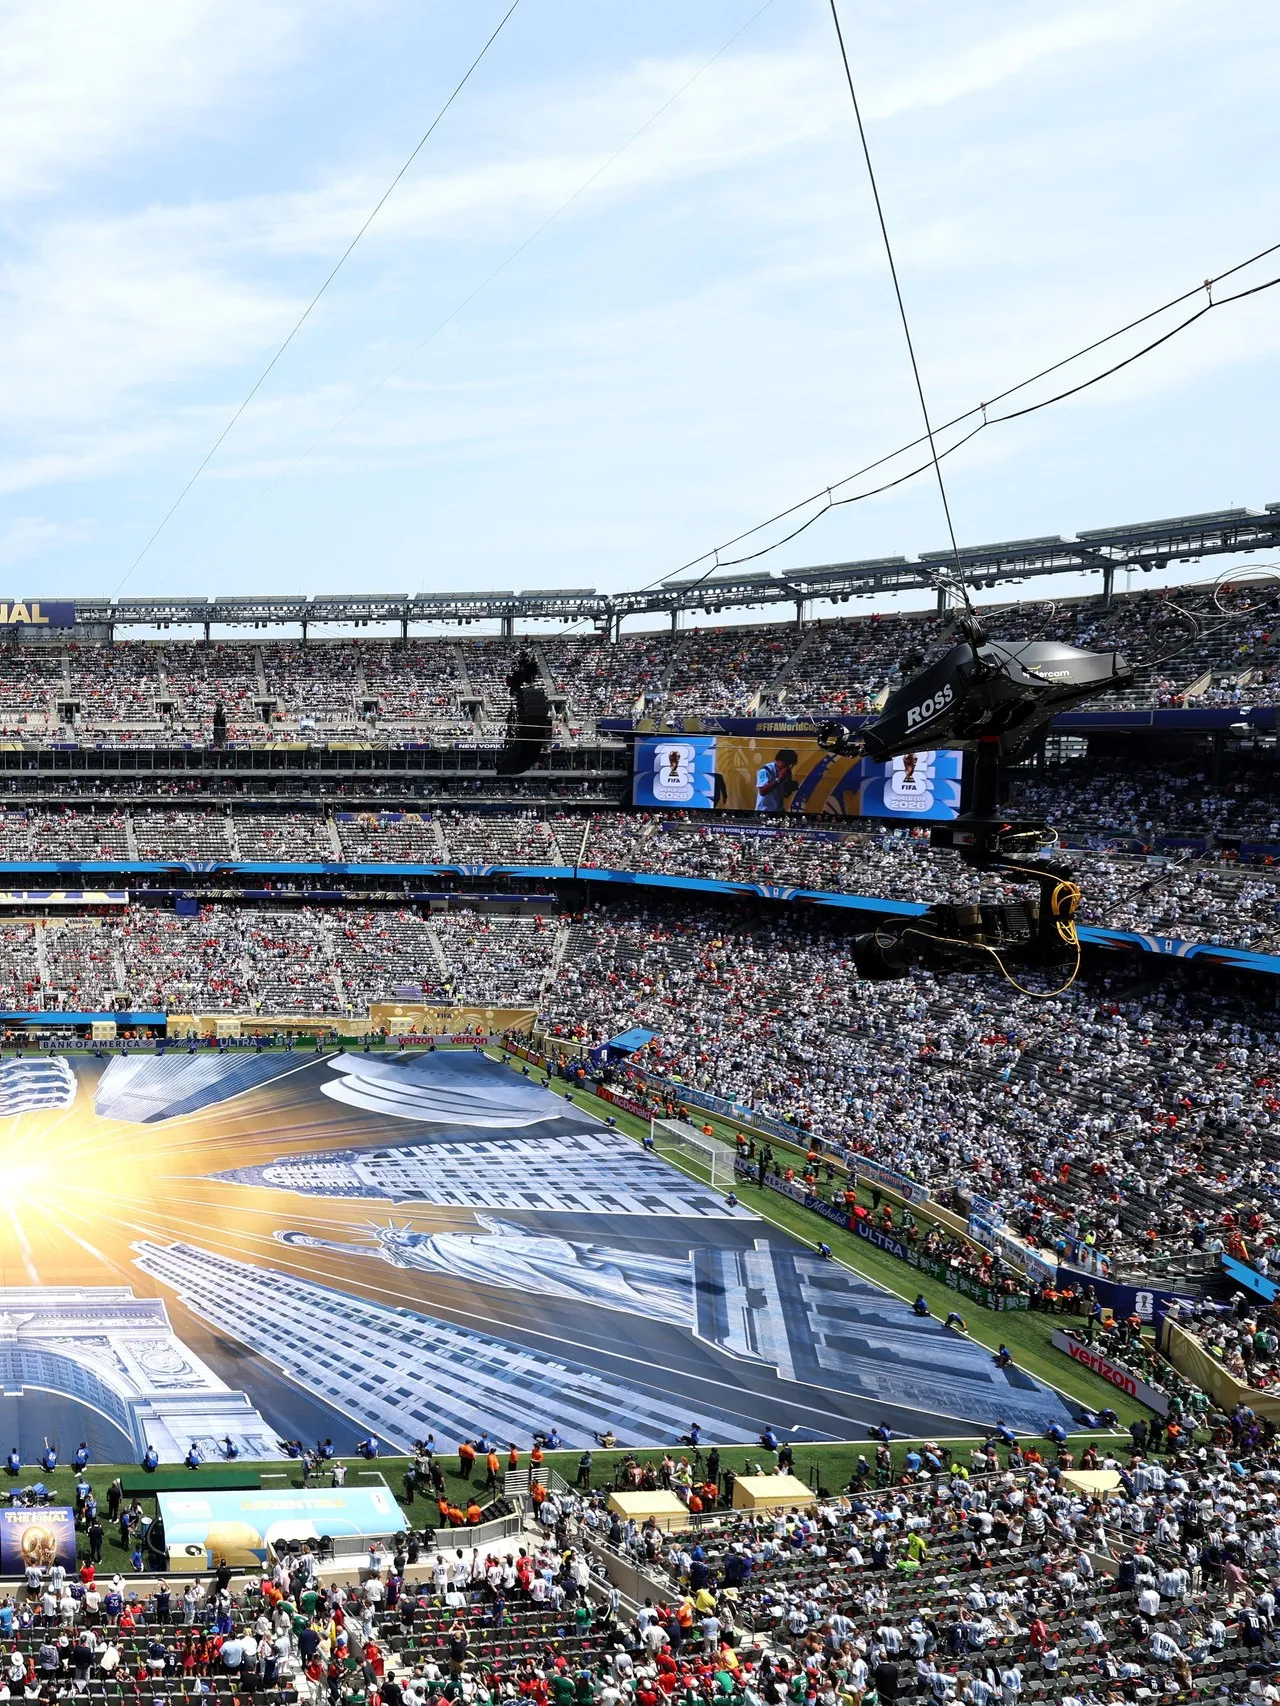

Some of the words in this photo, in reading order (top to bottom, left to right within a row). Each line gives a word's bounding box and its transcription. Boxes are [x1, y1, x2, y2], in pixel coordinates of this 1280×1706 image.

[907, 683, 953, 727] ROSS
[890, 800, 926, 809] 2026
[43, 1041, 72, 1049] BANK
[76, 1041, 89, 1049] OF
[90, 1040, 141, 1048] AMERICA
[170, 1038, 208, 1049] Michelob
[220, 1037, 258, 1047] ULTRA
[398, 1036, 434, 1045] verizon
[450, 1035, 488, 1045] verizon
[764, 1171, 794, 1196] MERICA
[805, 1196, 847, 1226] Michelob
[858, 1223, 904, 1258] ULTRA
[1067, 1341, 1137, 1397] verizon
[5, 1515, 27, 1523] THE
[28, 1514, 69, 1523] FINAL
[109, 1598, 119, 1607] 26
[1249, 1616, 1259, 1629] 10
